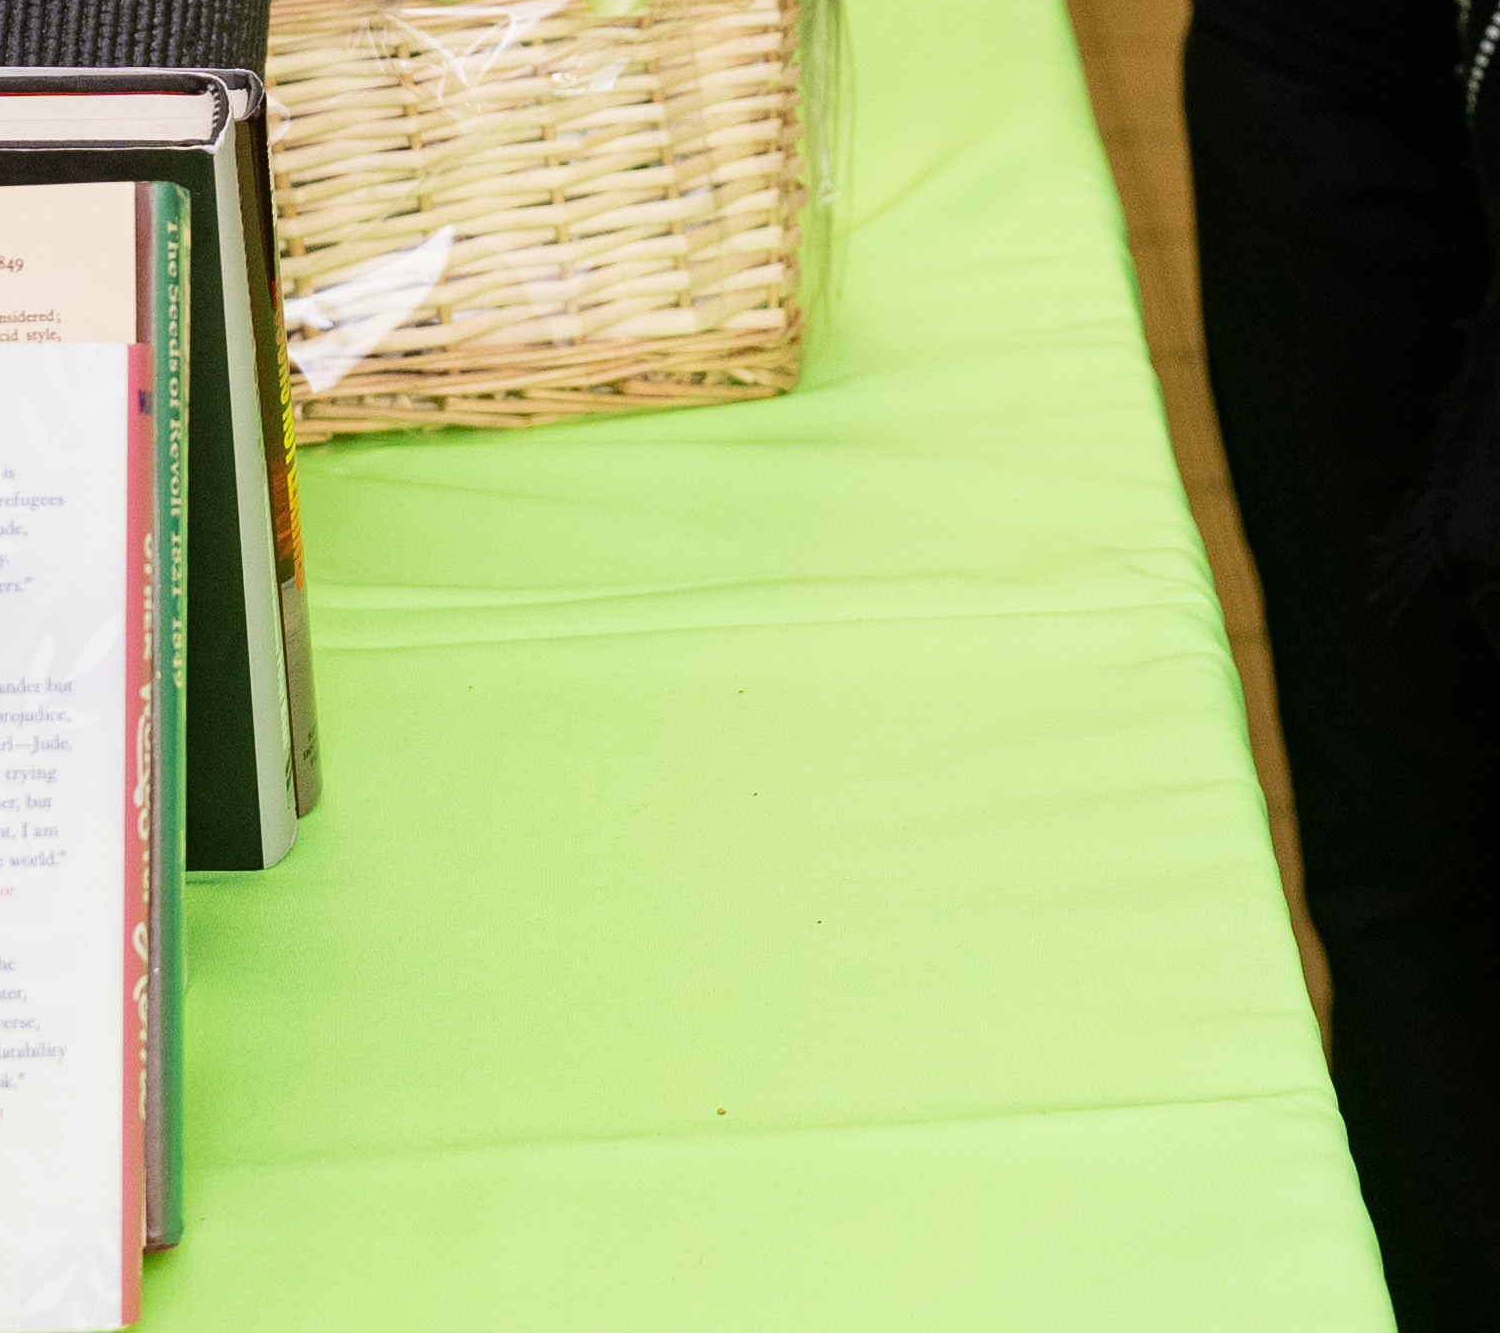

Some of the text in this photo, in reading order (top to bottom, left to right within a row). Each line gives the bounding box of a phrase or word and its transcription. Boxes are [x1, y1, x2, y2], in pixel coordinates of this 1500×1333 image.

[166, 218, 180, 275] The
[166, 284, 181, 371] Seeds
[168, 374, 181, 407] of
[3, 464, 15, 479] is
[168, 410, 182, 517] Revolt
